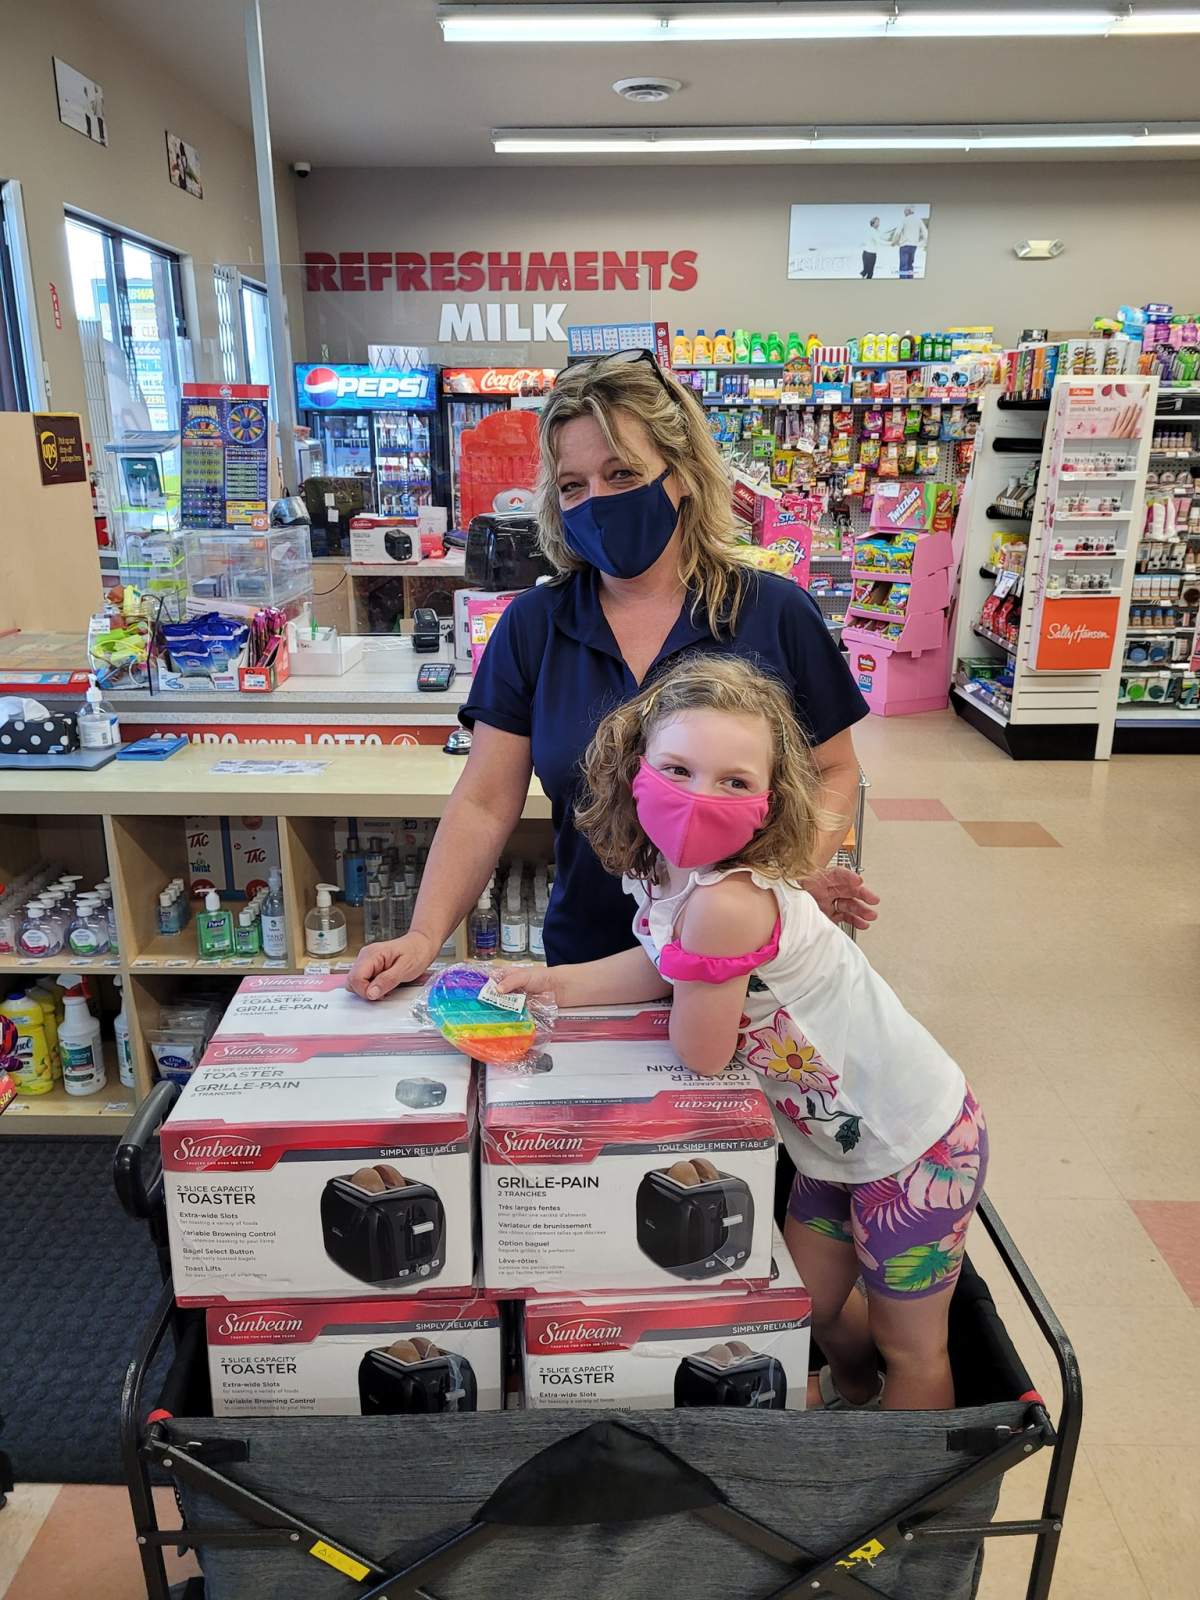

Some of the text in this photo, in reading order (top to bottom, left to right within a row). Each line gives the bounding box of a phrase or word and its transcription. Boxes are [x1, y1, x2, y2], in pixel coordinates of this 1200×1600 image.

[305, 250, 698, 292] REFRESHMENTS
[438, 303, 568, 342] MILK
[337, 374, 429, 398] PEPSI
[1047, 623, 1110, 645] Sally Hansen
[188, 833, 210, 848] TAG
[244, 848, 267, 864] TAG
[236, 1004, 329, 1013] GRILLE-PAIN
[214, 1045, 298, 1057] Sunbeam
[203, 1070, 284, 1080] TOASTER
[194, 1081, 300, 1092] GRILLE-PAIN
[674, 1098, 758, 1112] Sunbeam
[174, 1137, 261, 1160] Sunbeam
[496, 1131, 583, 1153] Sunbeam
[657, 1140, 769, 1151] TOUT SIMPLEMENT FIABLE
[380, 1145, 457, 1157] SIMPLY RELIABLE
[497, 1176, 599, 1189] GRILLE-PAIN
[177, 1193, 256, 1205] TOASTER
[219, 1313, 302, 1335] Sunbeam
[415, 1322, 445, 1330] SIMPLY
[732, 1321, 802, 1334] SIMPLY RELIABLE
[539, 1322, 621, 1345] Sunbeam
[220, 1363, 297, 1374] TOASTER
[572, 1365, 614, 1373] CAPACITY
[539, 1373, 615, 1384] TOASTER
